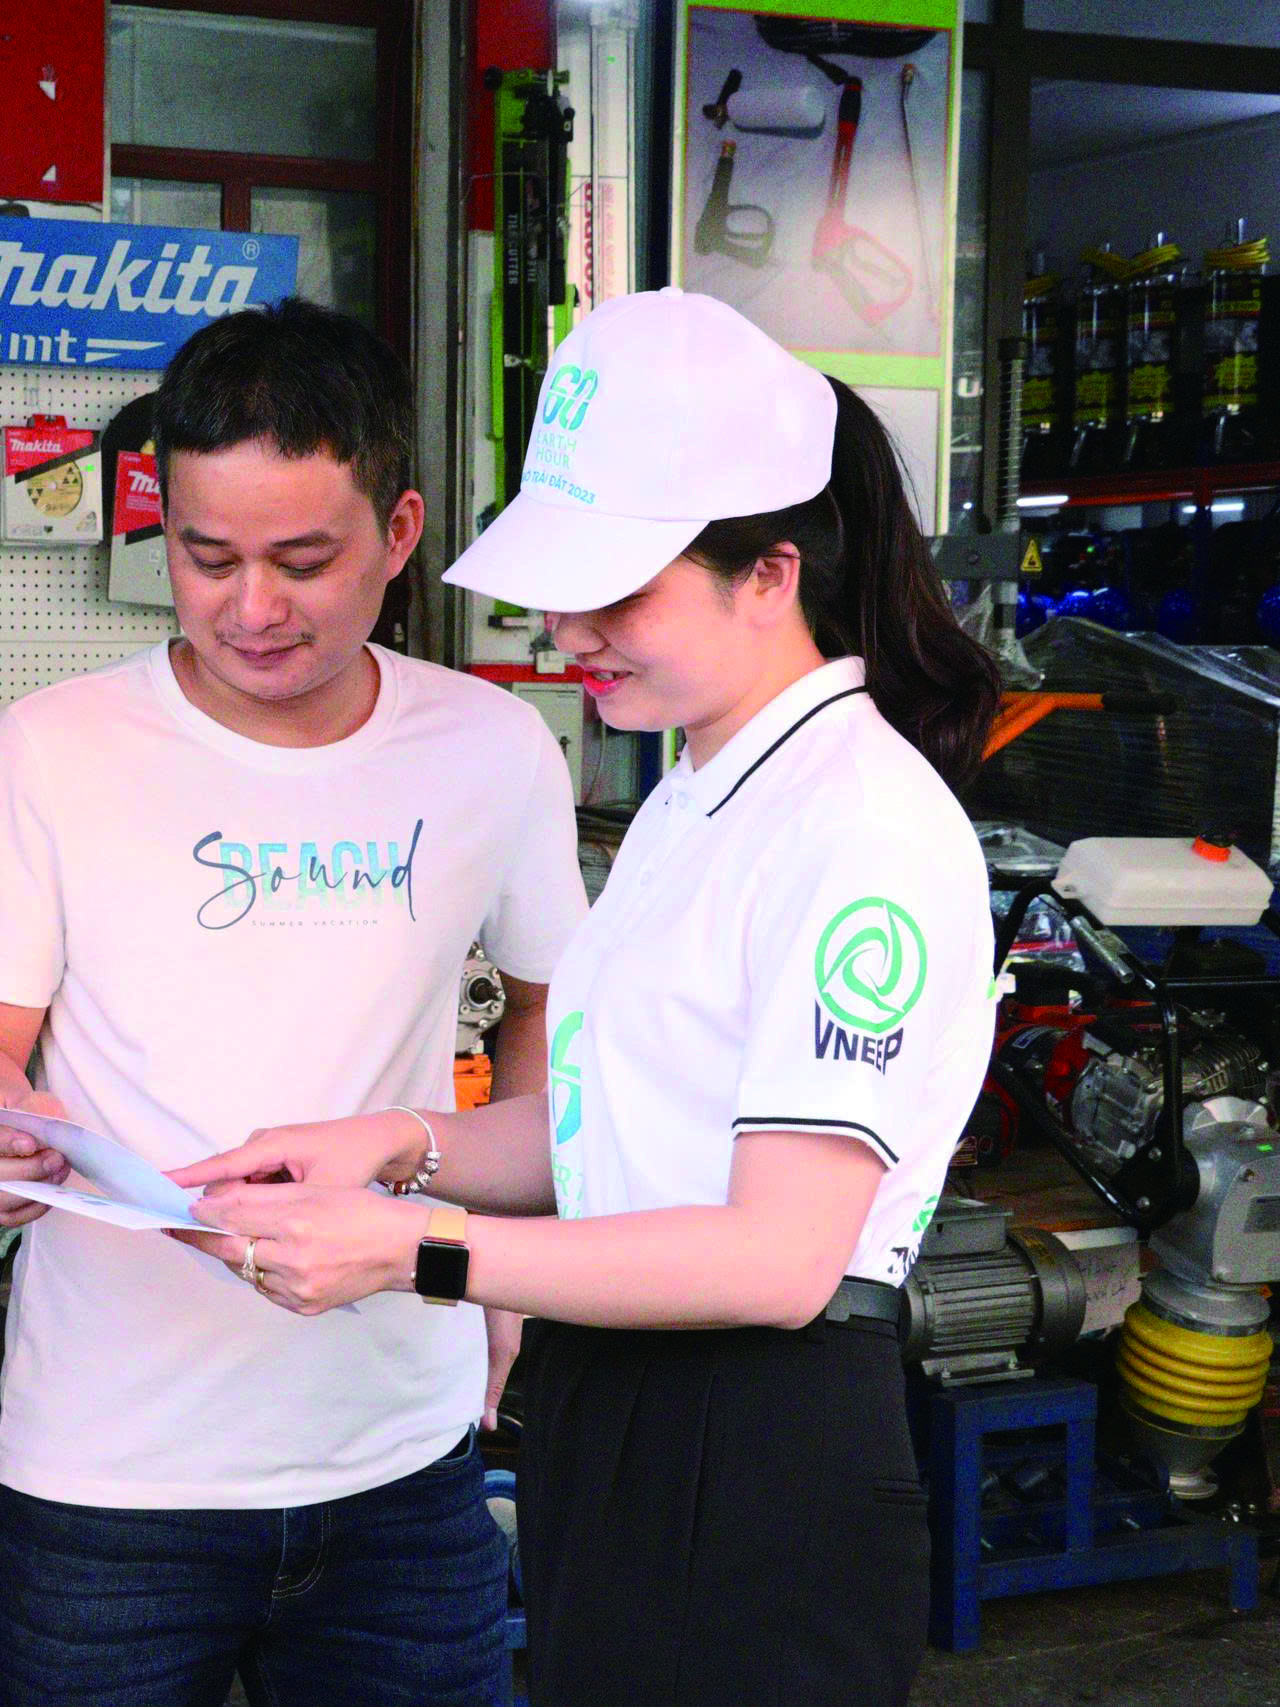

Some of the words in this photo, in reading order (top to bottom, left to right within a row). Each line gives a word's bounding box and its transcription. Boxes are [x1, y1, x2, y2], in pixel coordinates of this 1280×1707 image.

[8, 328, 77, 364] mt
[9, 437, 64, 453] Makita
[567, 483, 597, 505] 2023
[192, 818, 424, 930] Sound
[218, 841, 410, 910] BEACH
[251, 919, 304, 928] SUMMER
[314, 918, 379, 928] VACATION
[814, 999, 904, 1076] VNEEP
